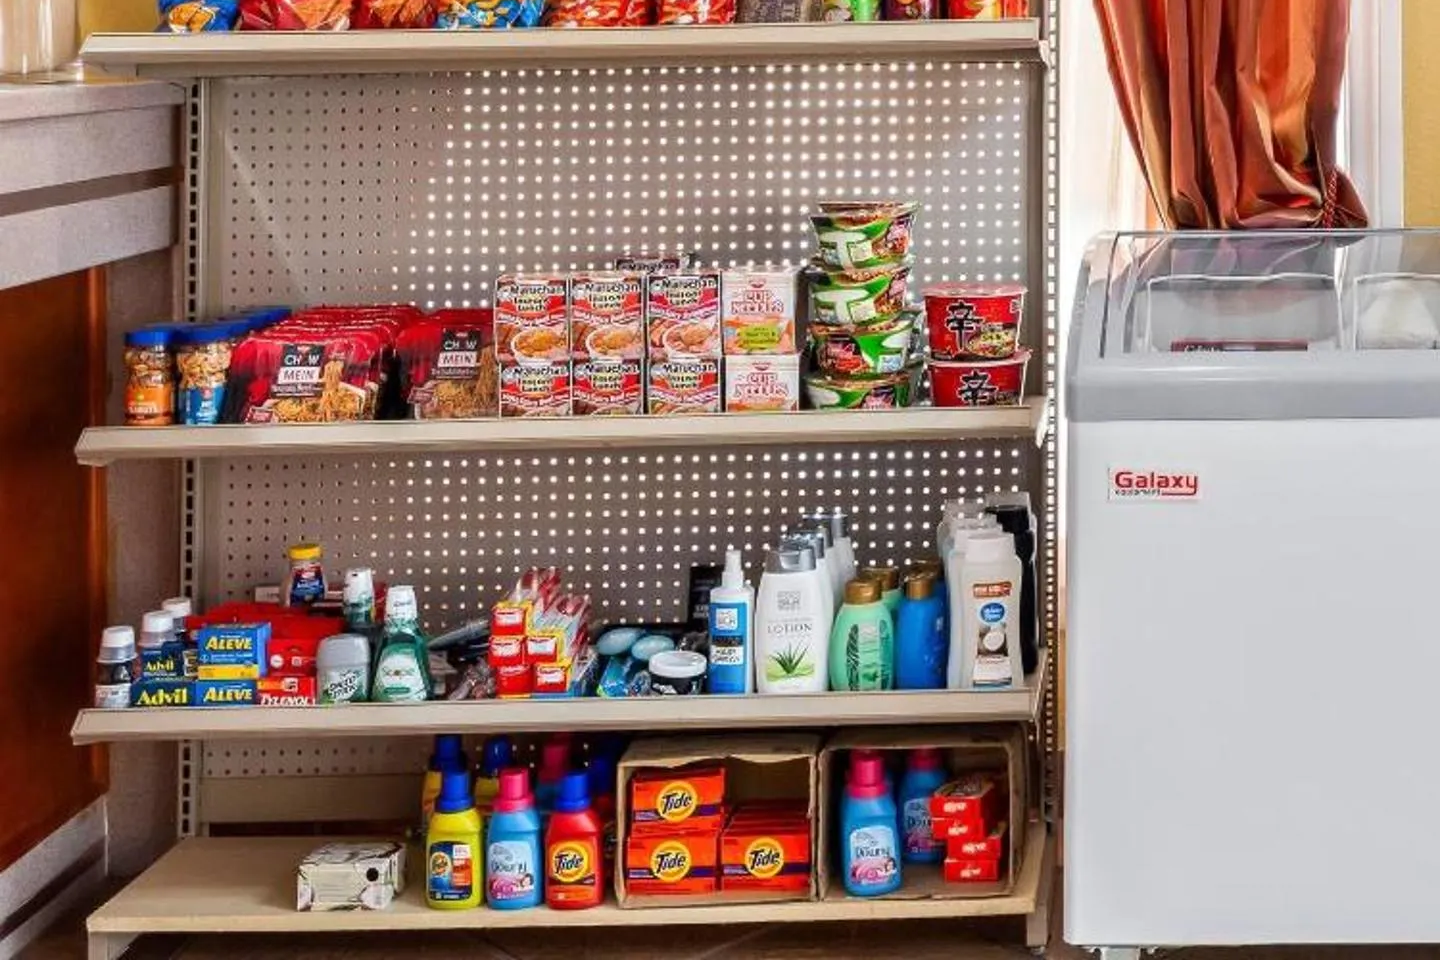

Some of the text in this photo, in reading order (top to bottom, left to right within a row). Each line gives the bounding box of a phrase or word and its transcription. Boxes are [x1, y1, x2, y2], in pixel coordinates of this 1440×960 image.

[444, 340, 477, 350] CHW
[284, 354, 320, 366] CHW
[443, 355, 473, 364] MEIN
[283, 369, 316, 381] MEIN
[1115, 472, 1198, 495] Galaxy
[767, 623, 813, 634] LOTION
[145, 659, 175, 671] Advil
[137, 687, 188, 705] Advil
[260, 693, 312, 706] TYLENOL
[662, 792, 692, 814] Tide
[555, 853, 584, 874] Tide
[656, 852, 686, 874] Tide
[748, 846, 781, 869] Tide
